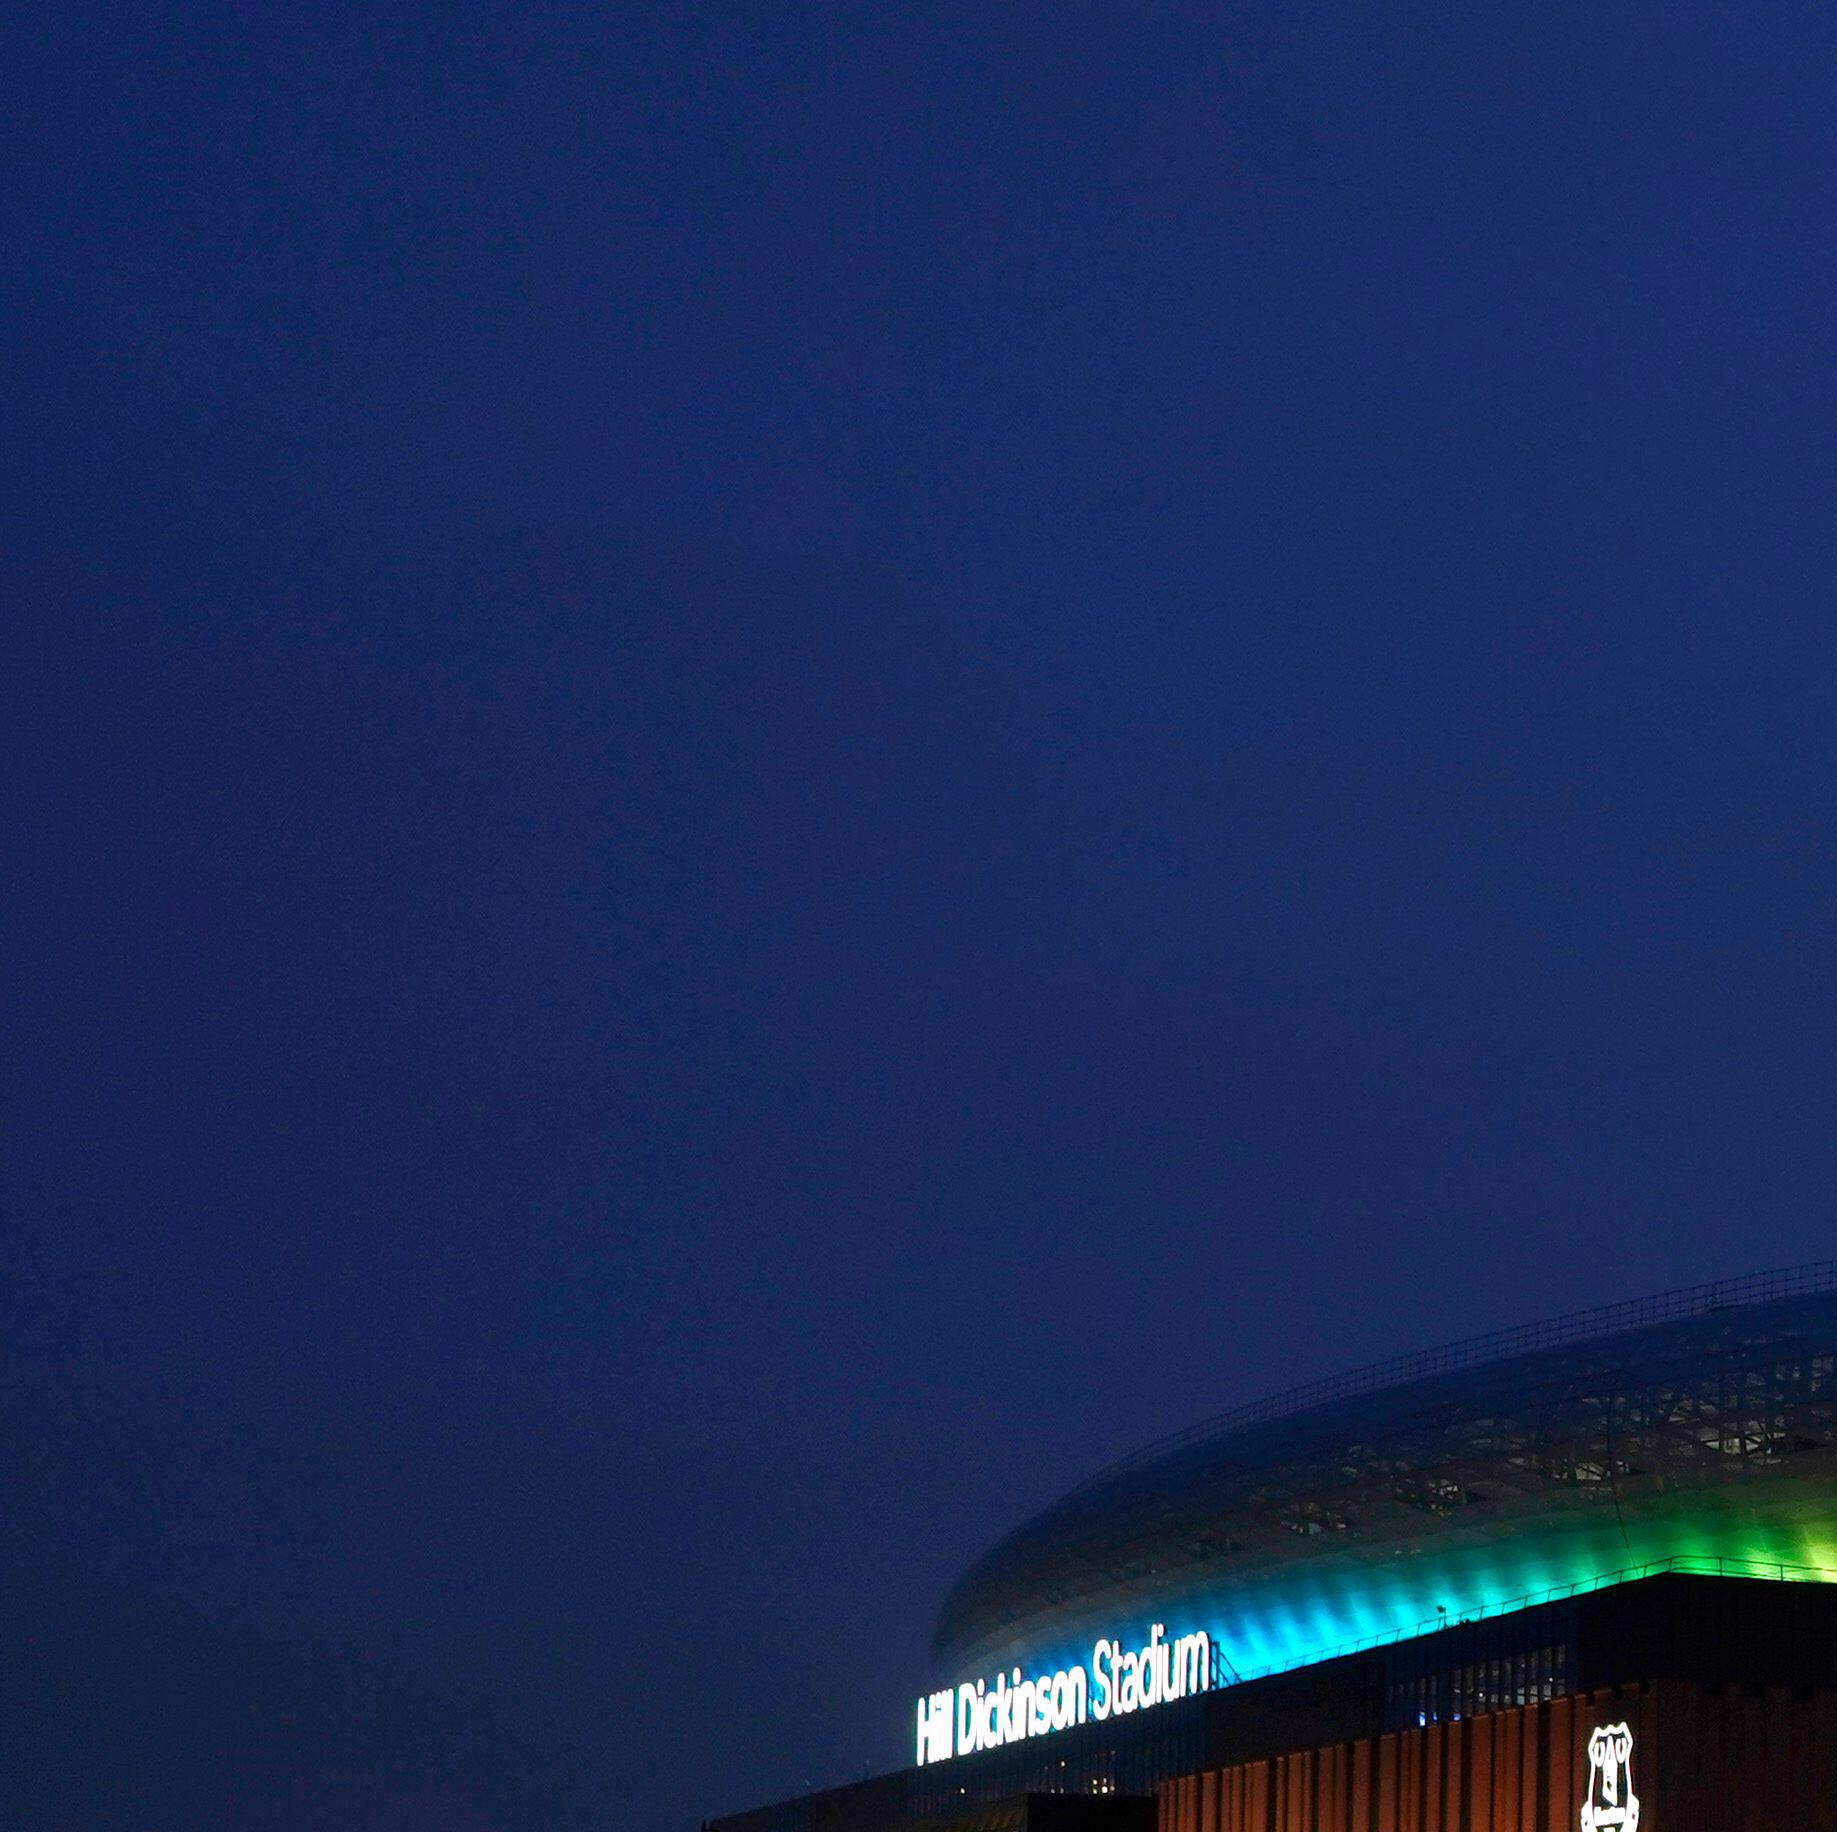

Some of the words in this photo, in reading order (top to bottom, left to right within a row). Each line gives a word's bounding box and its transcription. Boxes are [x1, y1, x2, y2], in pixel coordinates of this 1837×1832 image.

[916, 1688, 954, 1767] Hill
[957, 1665, 1087, 1756] Dickinson
[1092, 1623, 1210, 1721] Stadium
